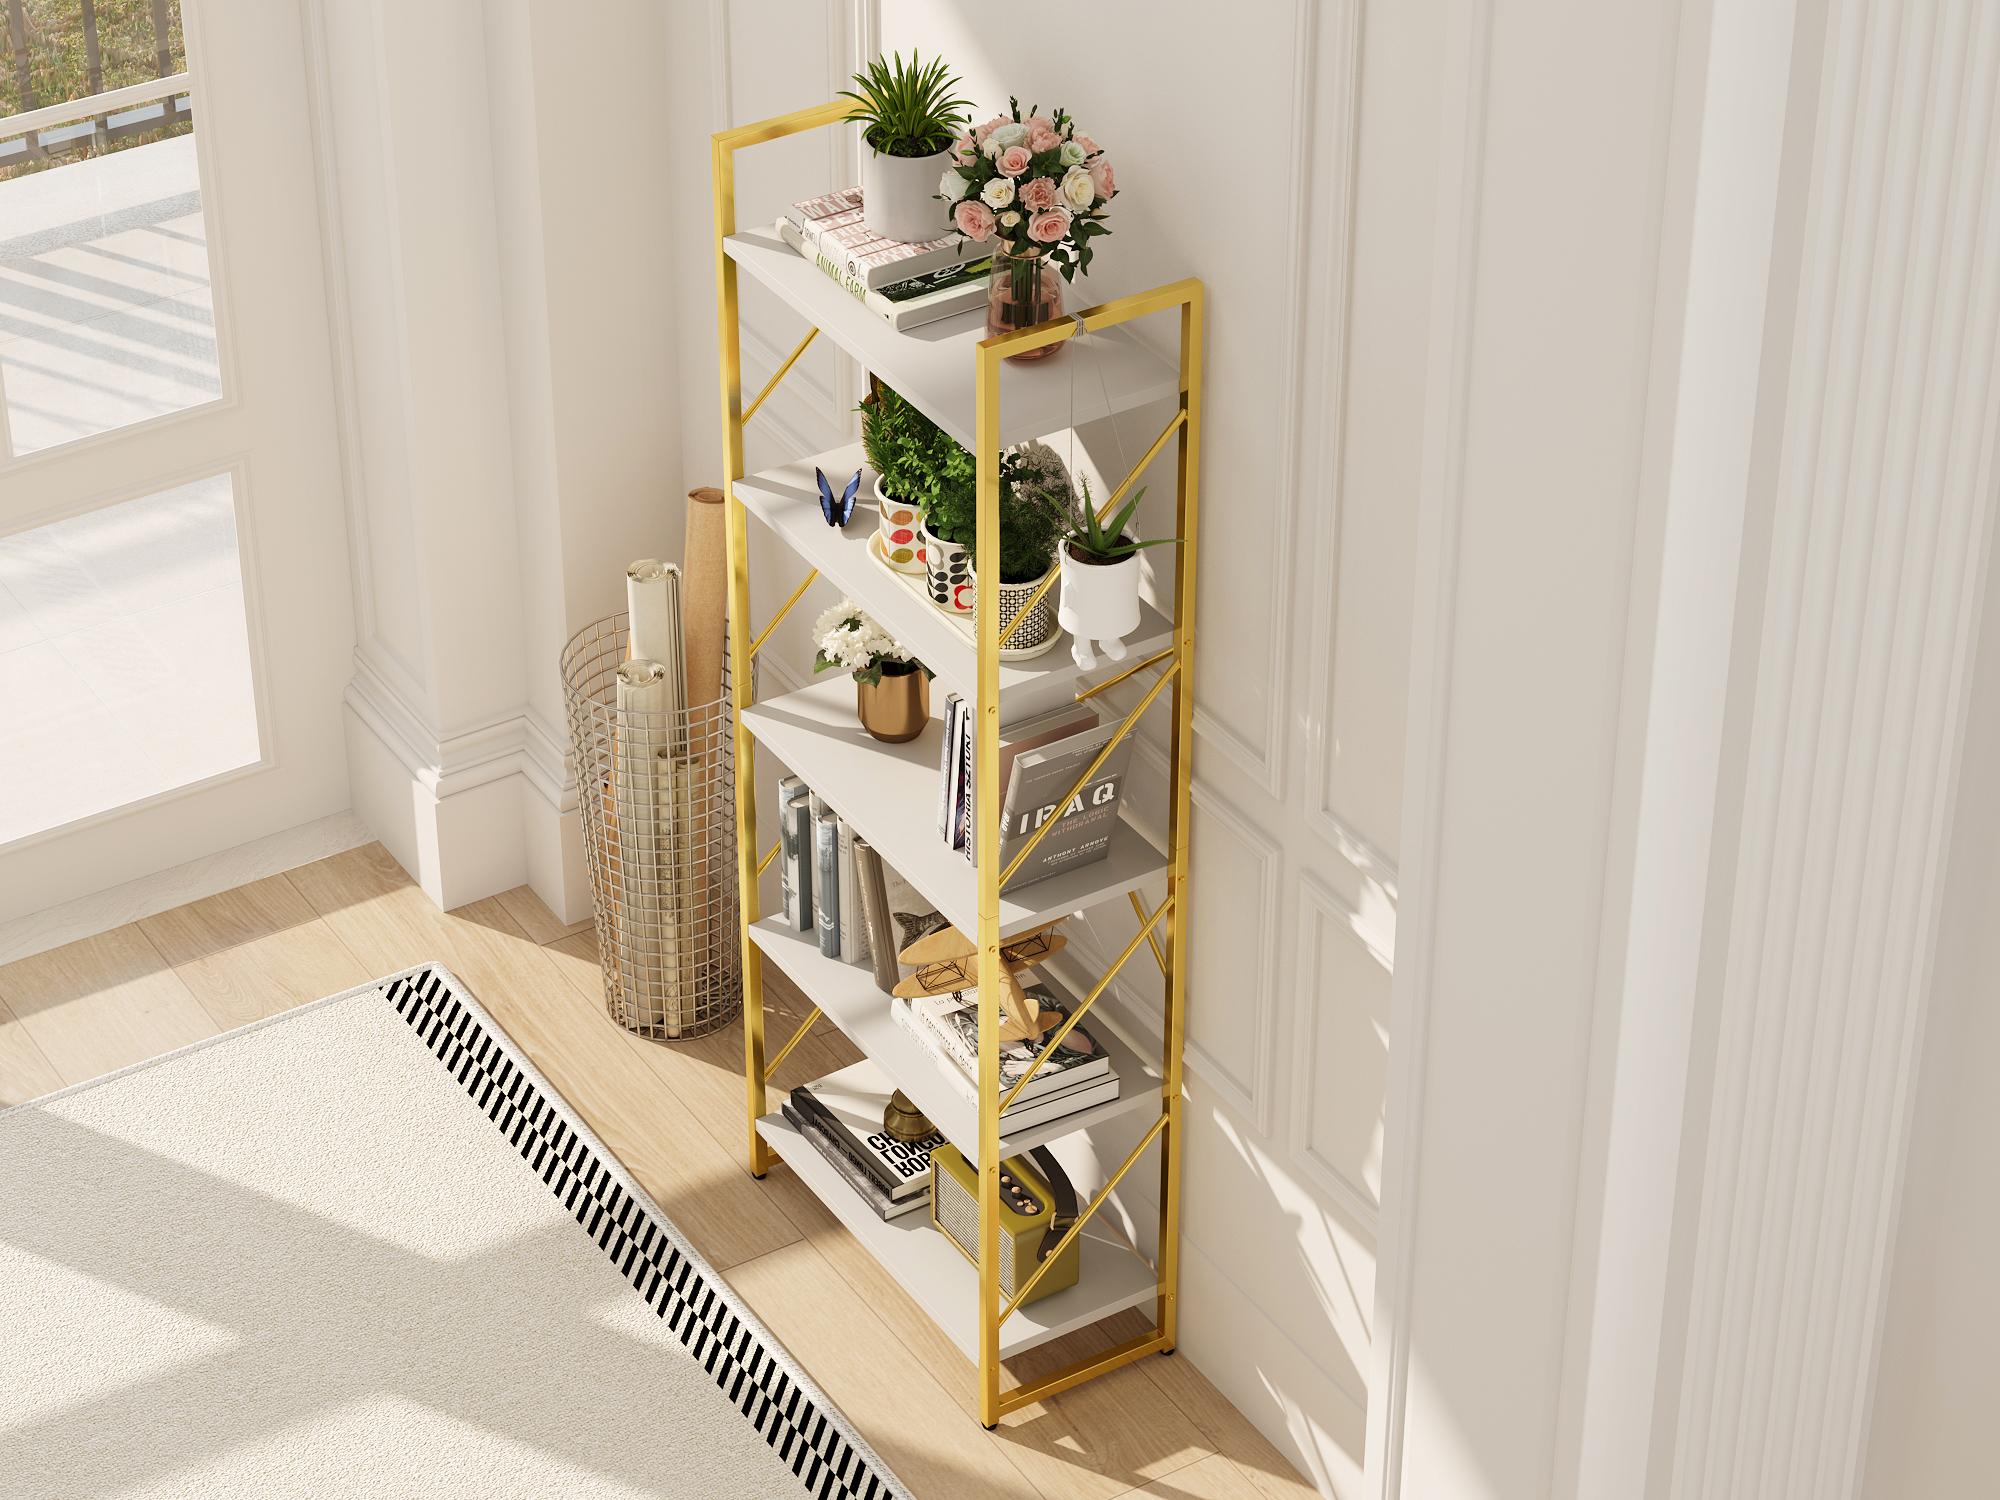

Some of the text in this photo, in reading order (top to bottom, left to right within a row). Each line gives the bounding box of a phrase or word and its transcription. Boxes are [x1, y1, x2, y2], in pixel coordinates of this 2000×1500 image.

[816, 253, 843, 287] ANIMAL
[845, 276, 867, 304] FARM
[1020, 782, 1115, 835] IRAQ
[1042, 848, 1077, 863] ANTHONY
